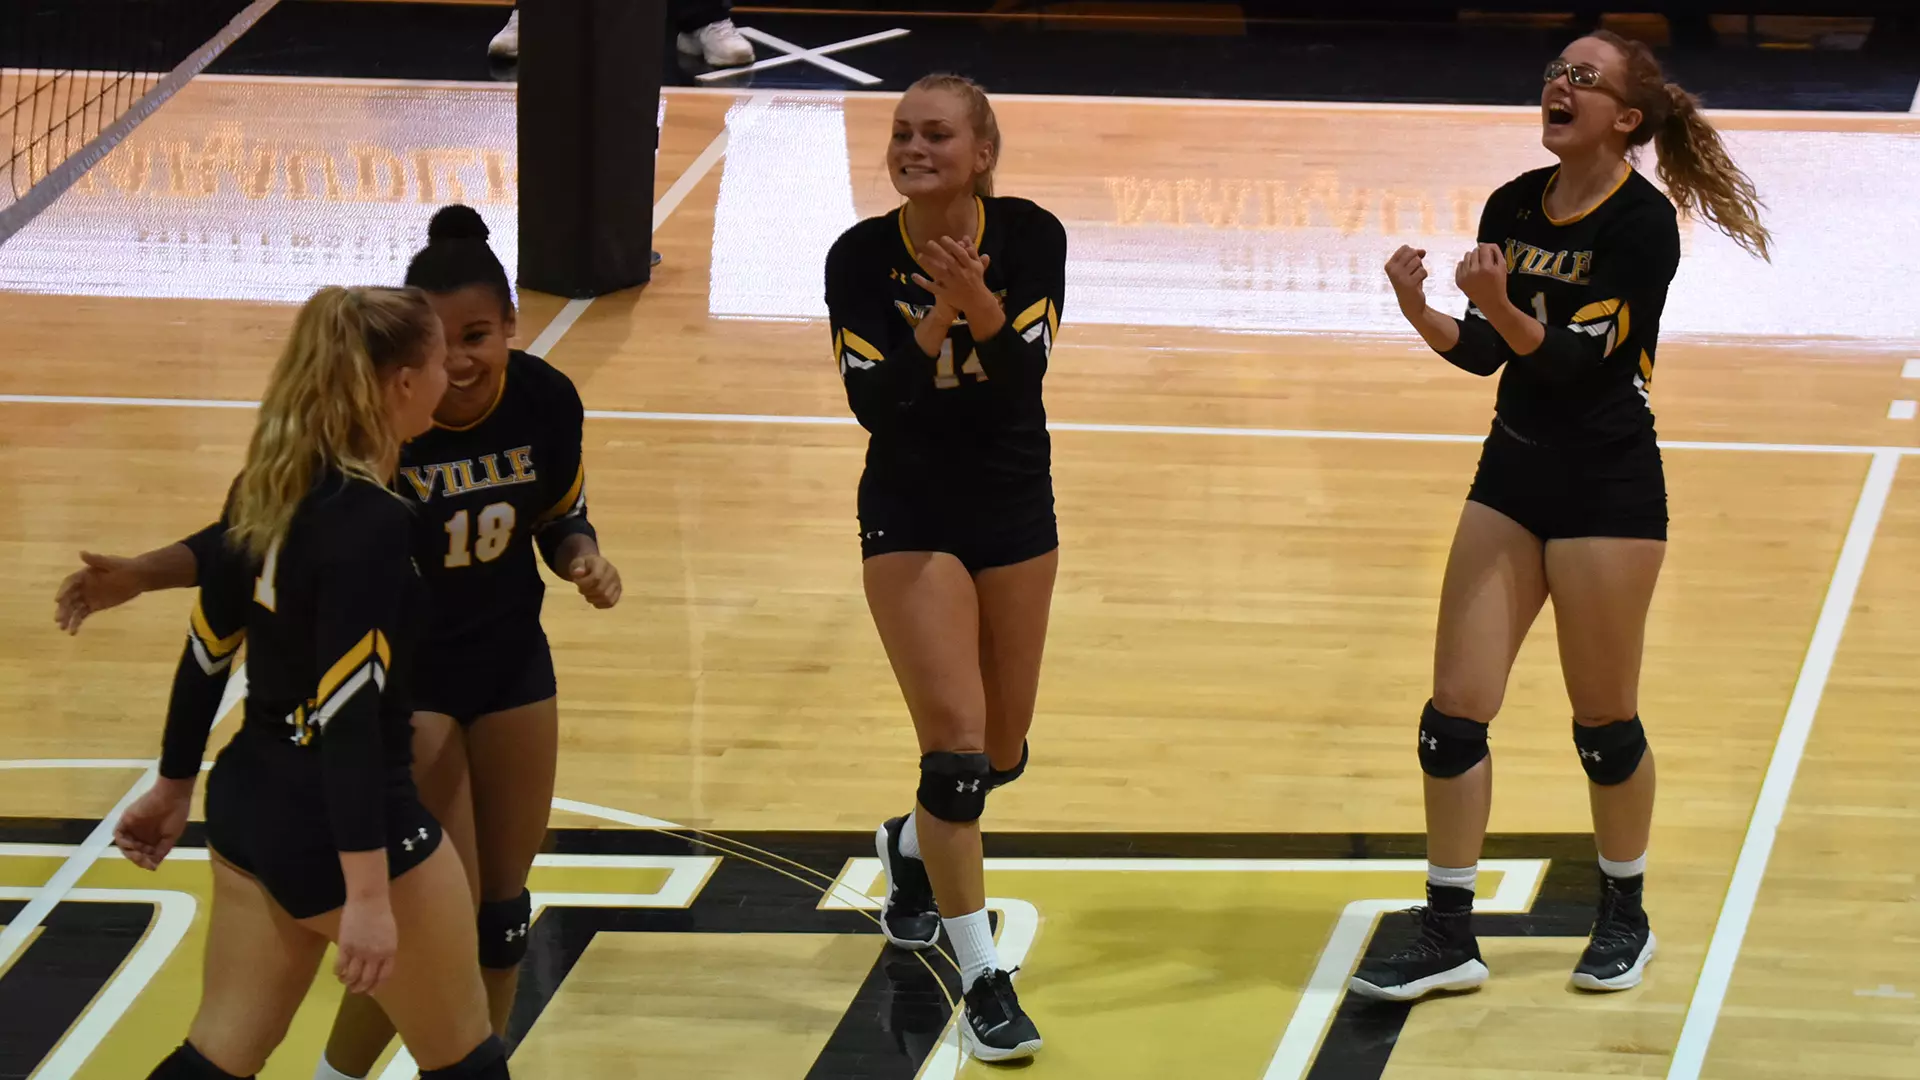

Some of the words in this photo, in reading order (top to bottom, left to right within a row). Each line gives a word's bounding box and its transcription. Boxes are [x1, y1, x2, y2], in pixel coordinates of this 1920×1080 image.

[1503, 237, 1593, 286] VILLE
[1530, 291, 1548, 325] 1
[400, 445, 536, 503] VILLE
[443, 501, 516, 568] 18
